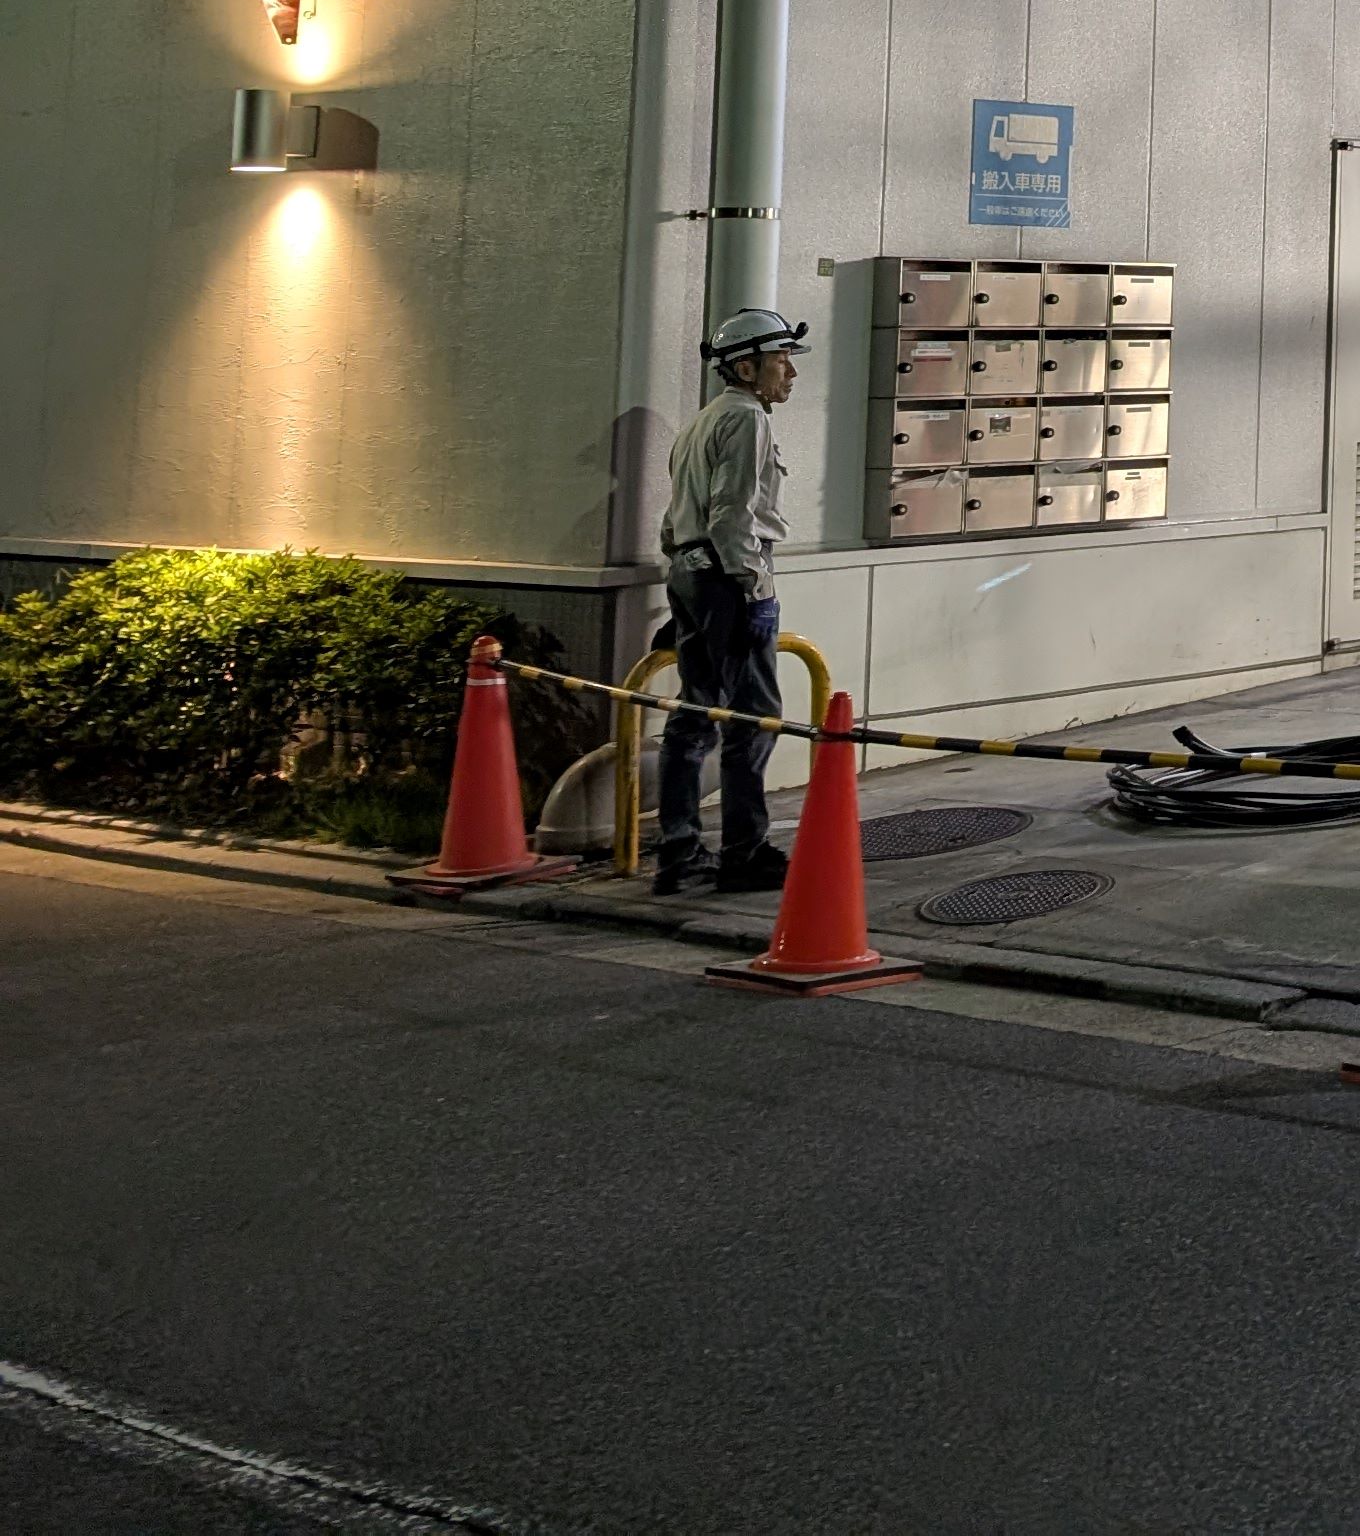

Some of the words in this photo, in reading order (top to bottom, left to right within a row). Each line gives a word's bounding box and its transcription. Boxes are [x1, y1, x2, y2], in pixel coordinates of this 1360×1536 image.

[981, 169, 1062, 194] 搬入車専用
